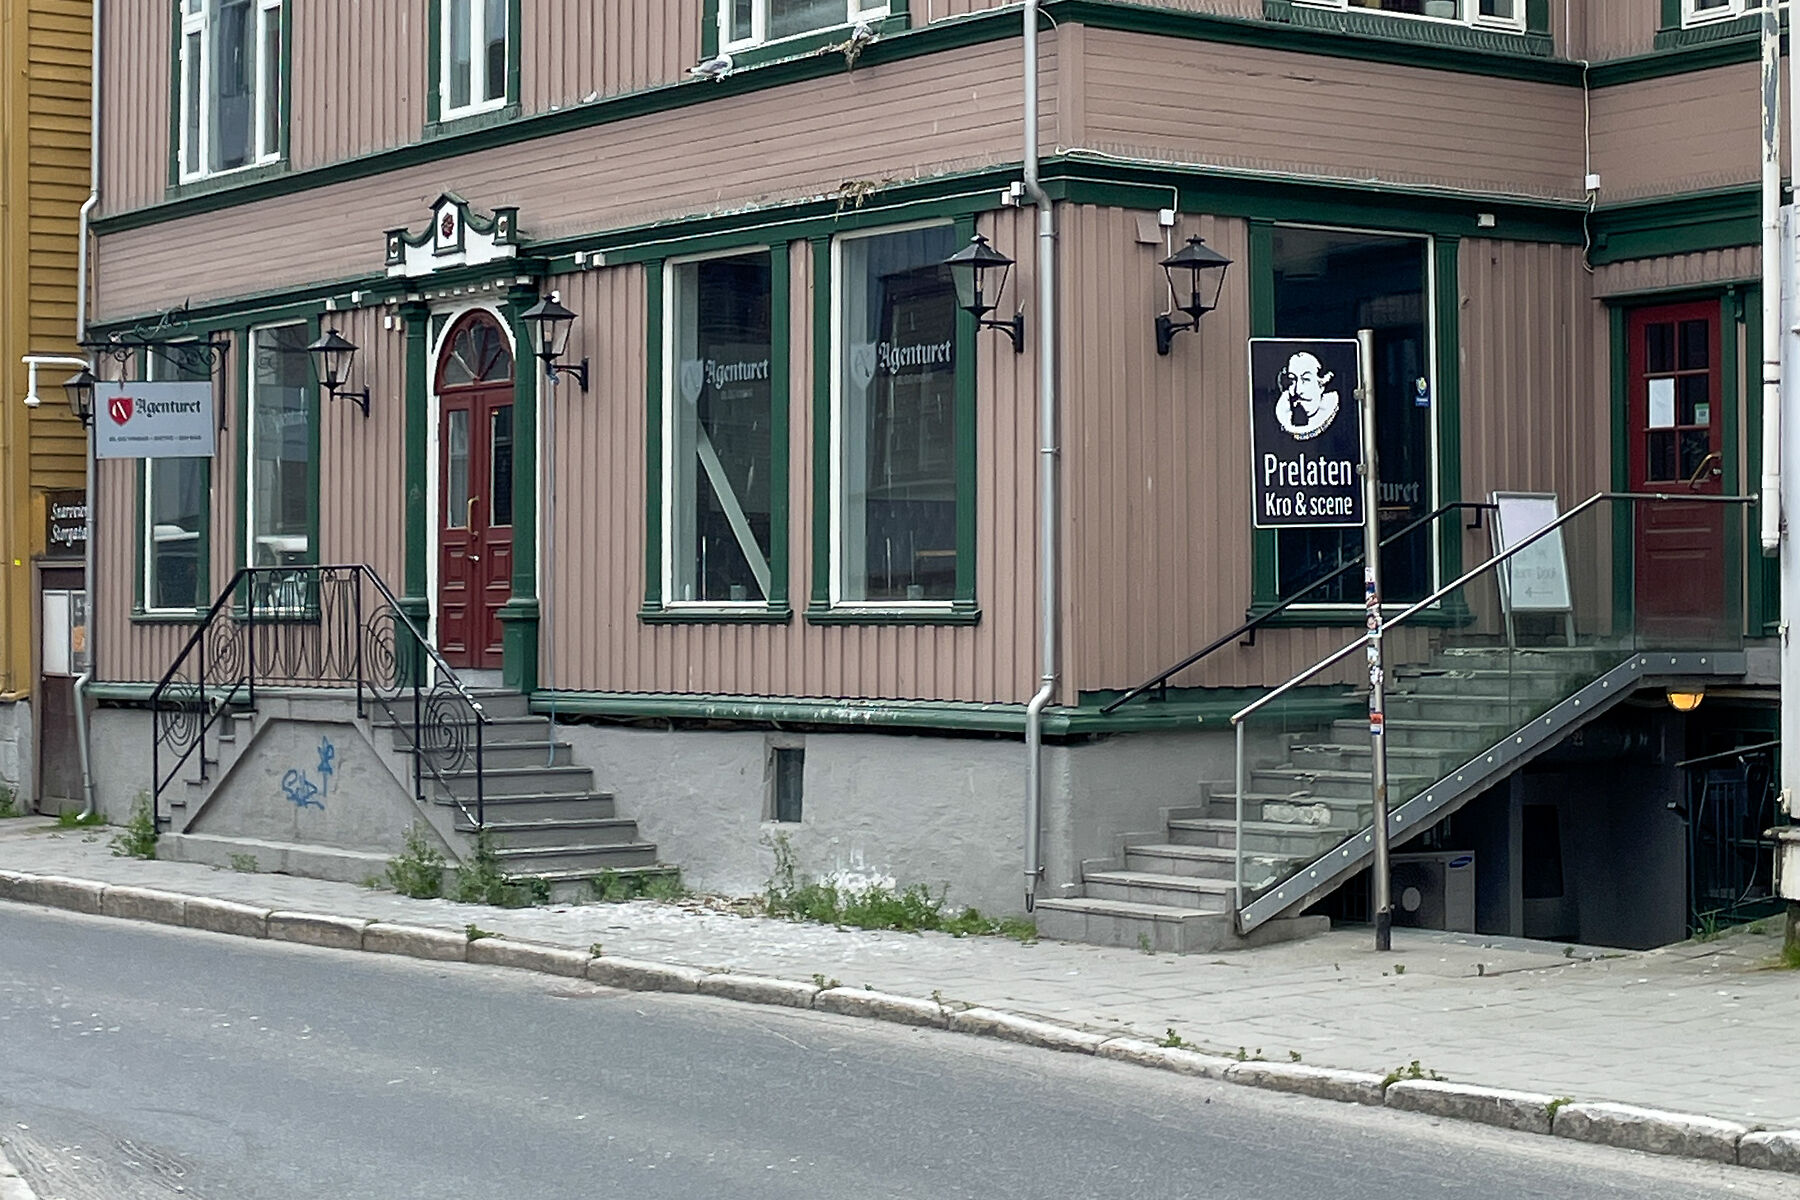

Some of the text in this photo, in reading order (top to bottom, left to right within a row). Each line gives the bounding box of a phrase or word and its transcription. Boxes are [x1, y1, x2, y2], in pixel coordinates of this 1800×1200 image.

[879, 340, 952, 375] Agenturet
[705, 359, 768, 390] Agenturet
[135, 398, 201, 418] Agenturet
[1264, 452, 1352, 487] Prelaten
[1265, 492, 1292, 516] Kro
[1294, 491, 1307, 516] &
[1309, 496, 1353, 516] scene
